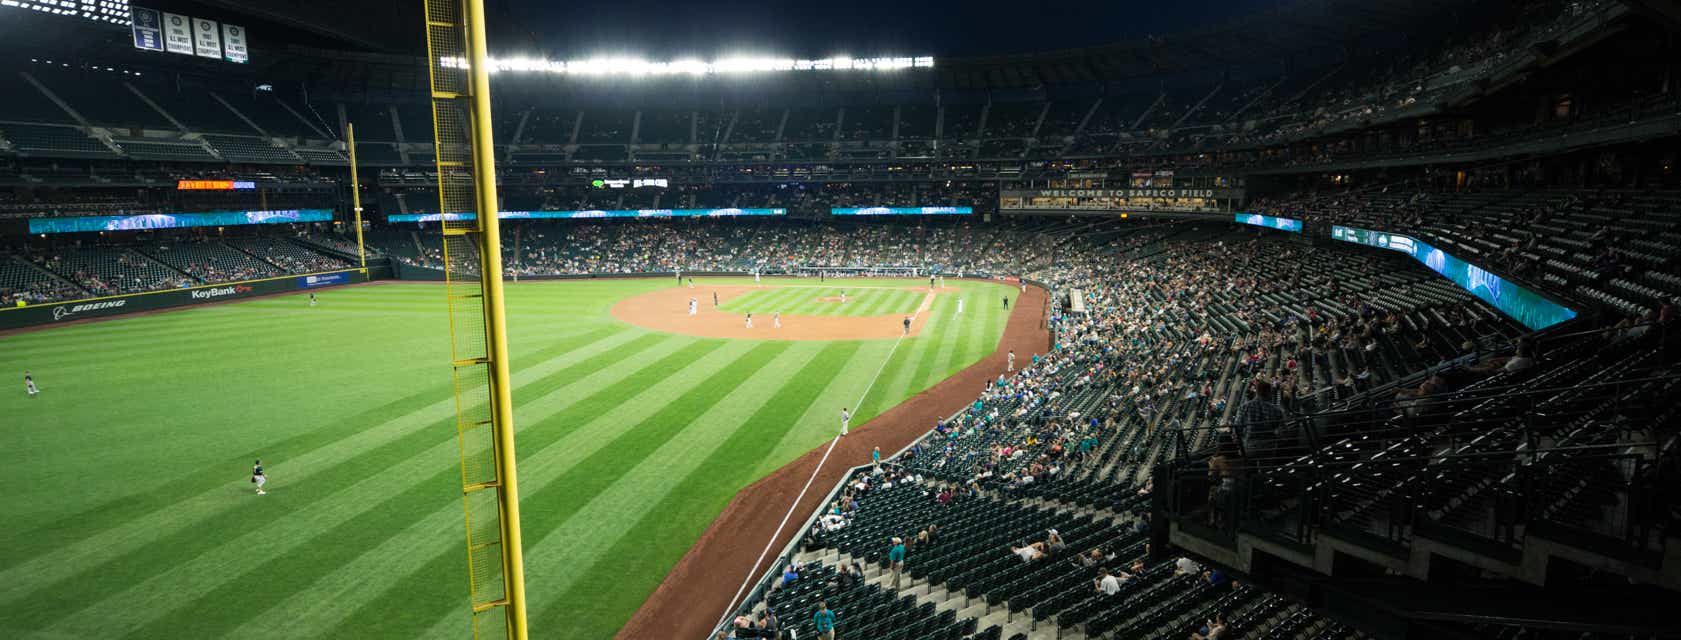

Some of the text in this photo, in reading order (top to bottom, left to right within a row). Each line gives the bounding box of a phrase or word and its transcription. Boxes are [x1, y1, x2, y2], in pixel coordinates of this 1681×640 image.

[1040, 189, 1213, 197] WELCOME TO SAFECO FIELD
[191, 286, 236, 299] KeyBank
[71, 300, 126, 312] BOEING
